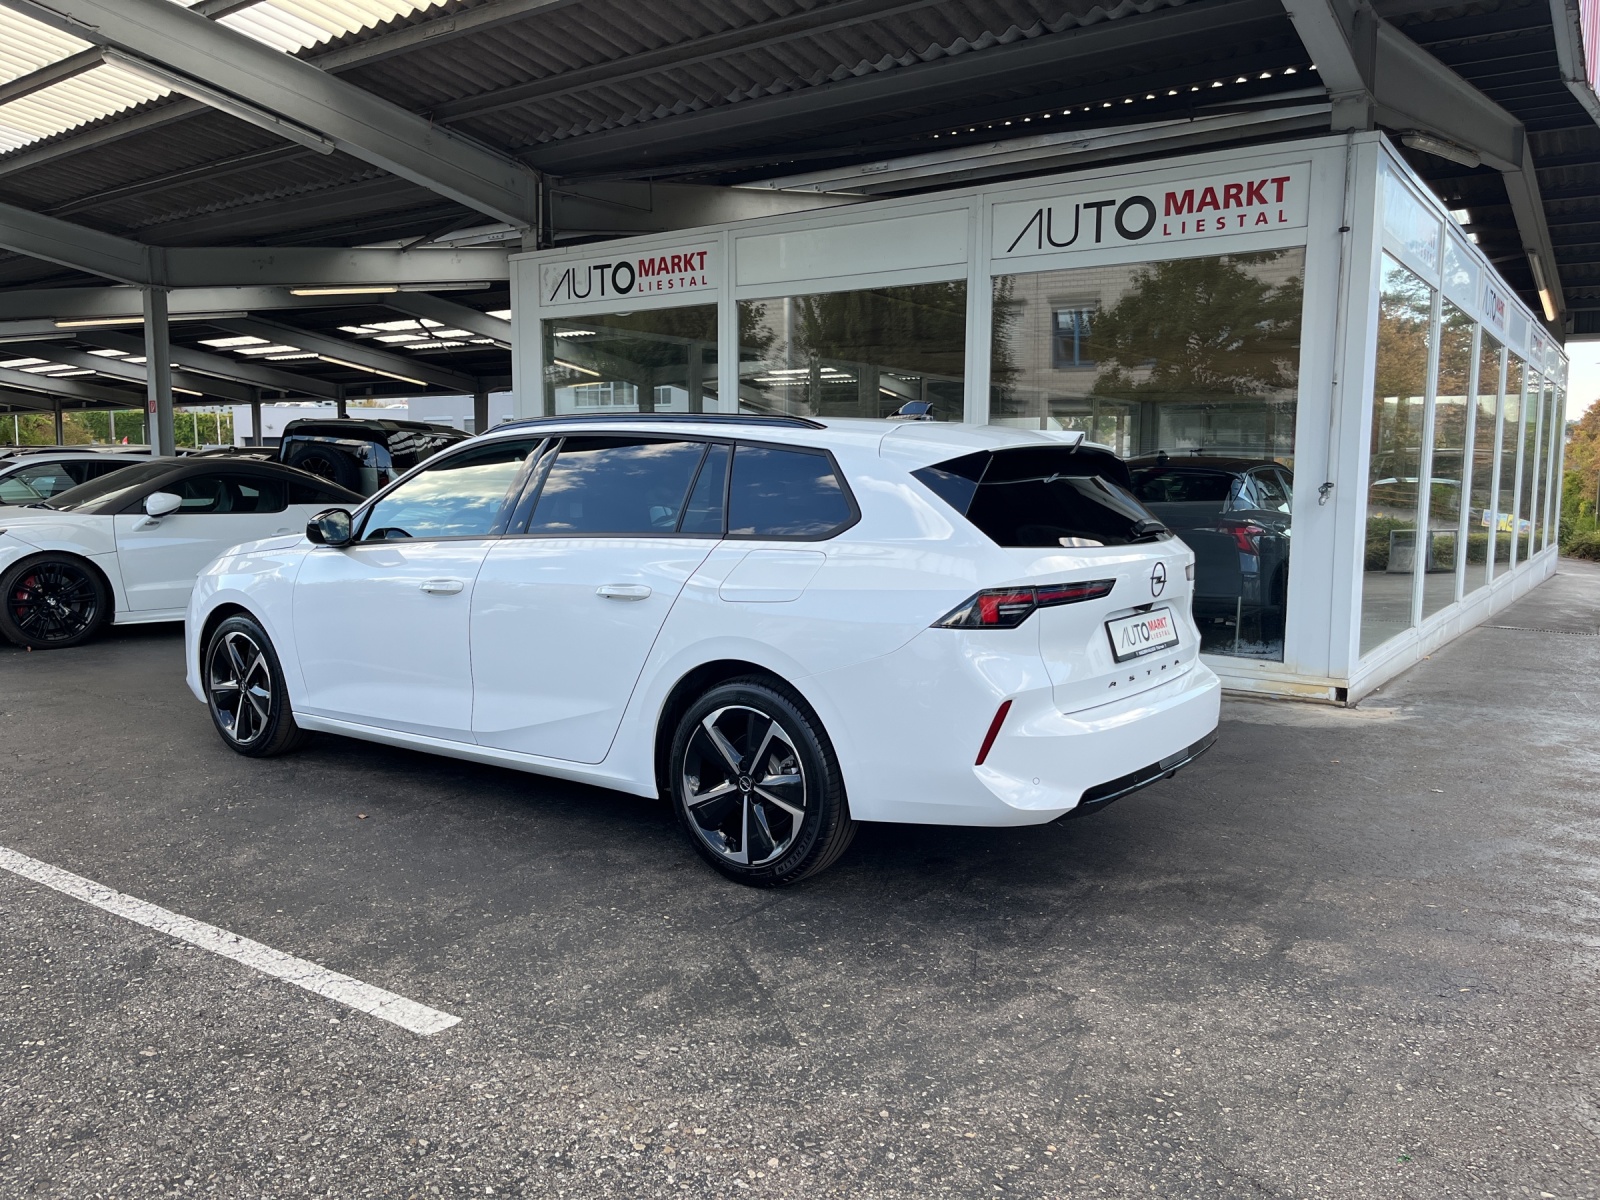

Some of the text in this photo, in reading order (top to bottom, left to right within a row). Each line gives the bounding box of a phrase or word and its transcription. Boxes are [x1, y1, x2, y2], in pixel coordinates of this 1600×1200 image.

[1006, 176, 1291, 253] AUTO MARKT
[1163, 209, 1288, 236] LIESTAL
[549, 251, 708, 302] AUTO MARKT
[638, 275, 708, 293] LIESTAL
[1121, 617, 1168, 649] AUTO MARKT
[1108, 660, 1180, 688] ASTRA
[777, 830, 813, 874] MICHELIN
